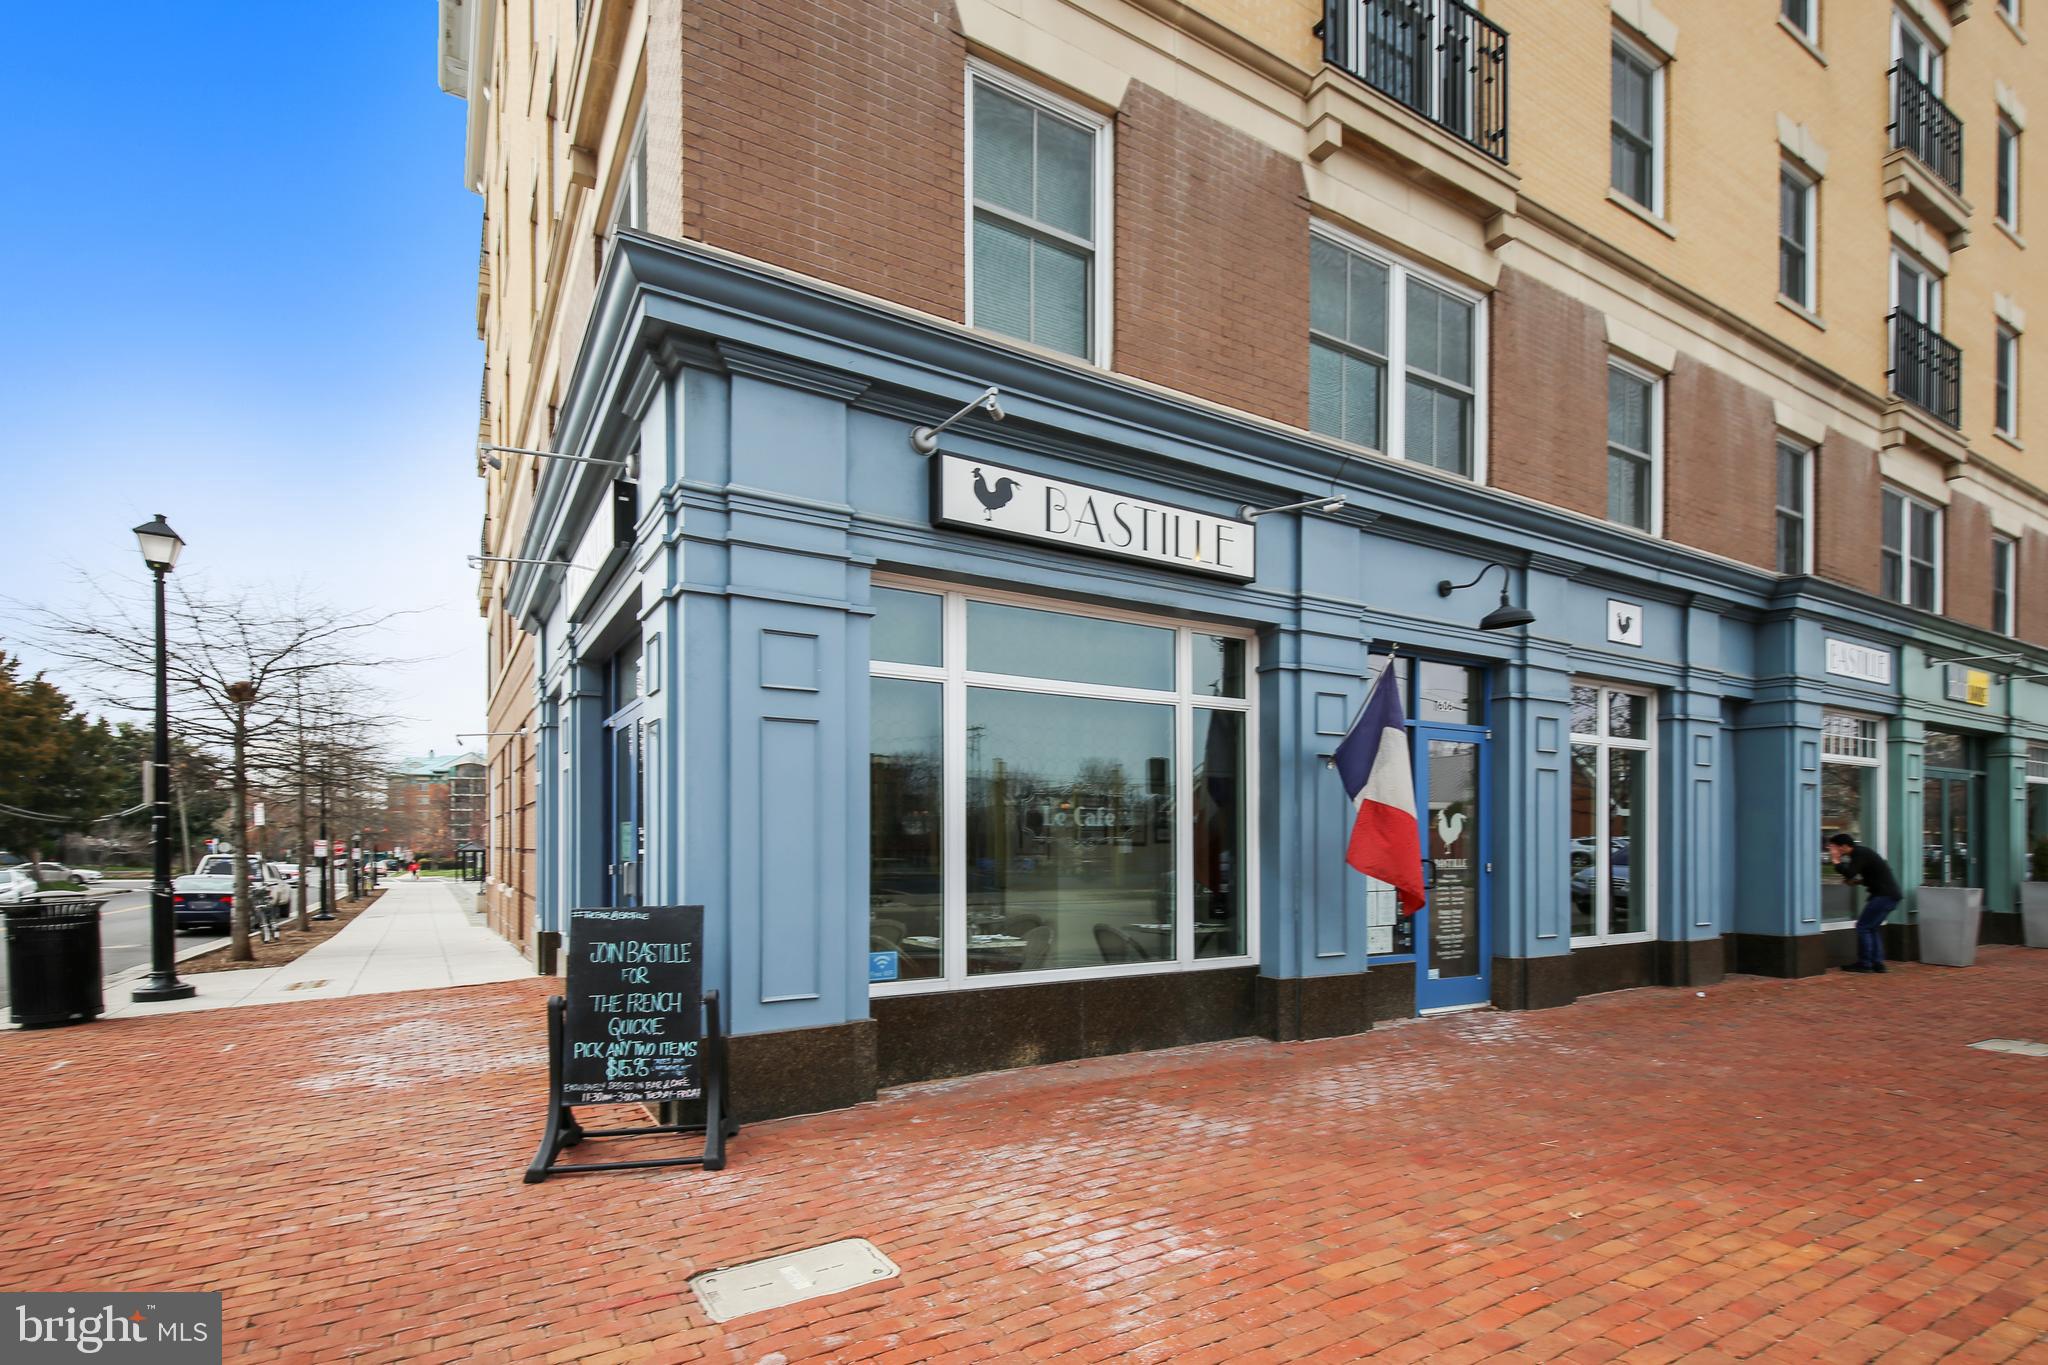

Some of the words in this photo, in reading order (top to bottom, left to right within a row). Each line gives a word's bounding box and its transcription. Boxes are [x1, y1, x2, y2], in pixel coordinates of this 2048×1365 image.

[1045, 486, 1234, 568] BASTILLE
[588, 941, 625, 964] JOIN
[626, 941, 692, 963] BASTILLE
[621, 966, 650, 984] FOR
[588, 994, 624, 1013] THE
[626, 992, 682, 1013] FRENCH
[608, 1017, 665, 1041] QUICKIE
[574, 1042, 605, 1060] PICK
[605, 1040, 632, 1058] ANY
[631, 1040, 656, 1057] TWO
[659, 1041, 698, 1057] ITEMS
